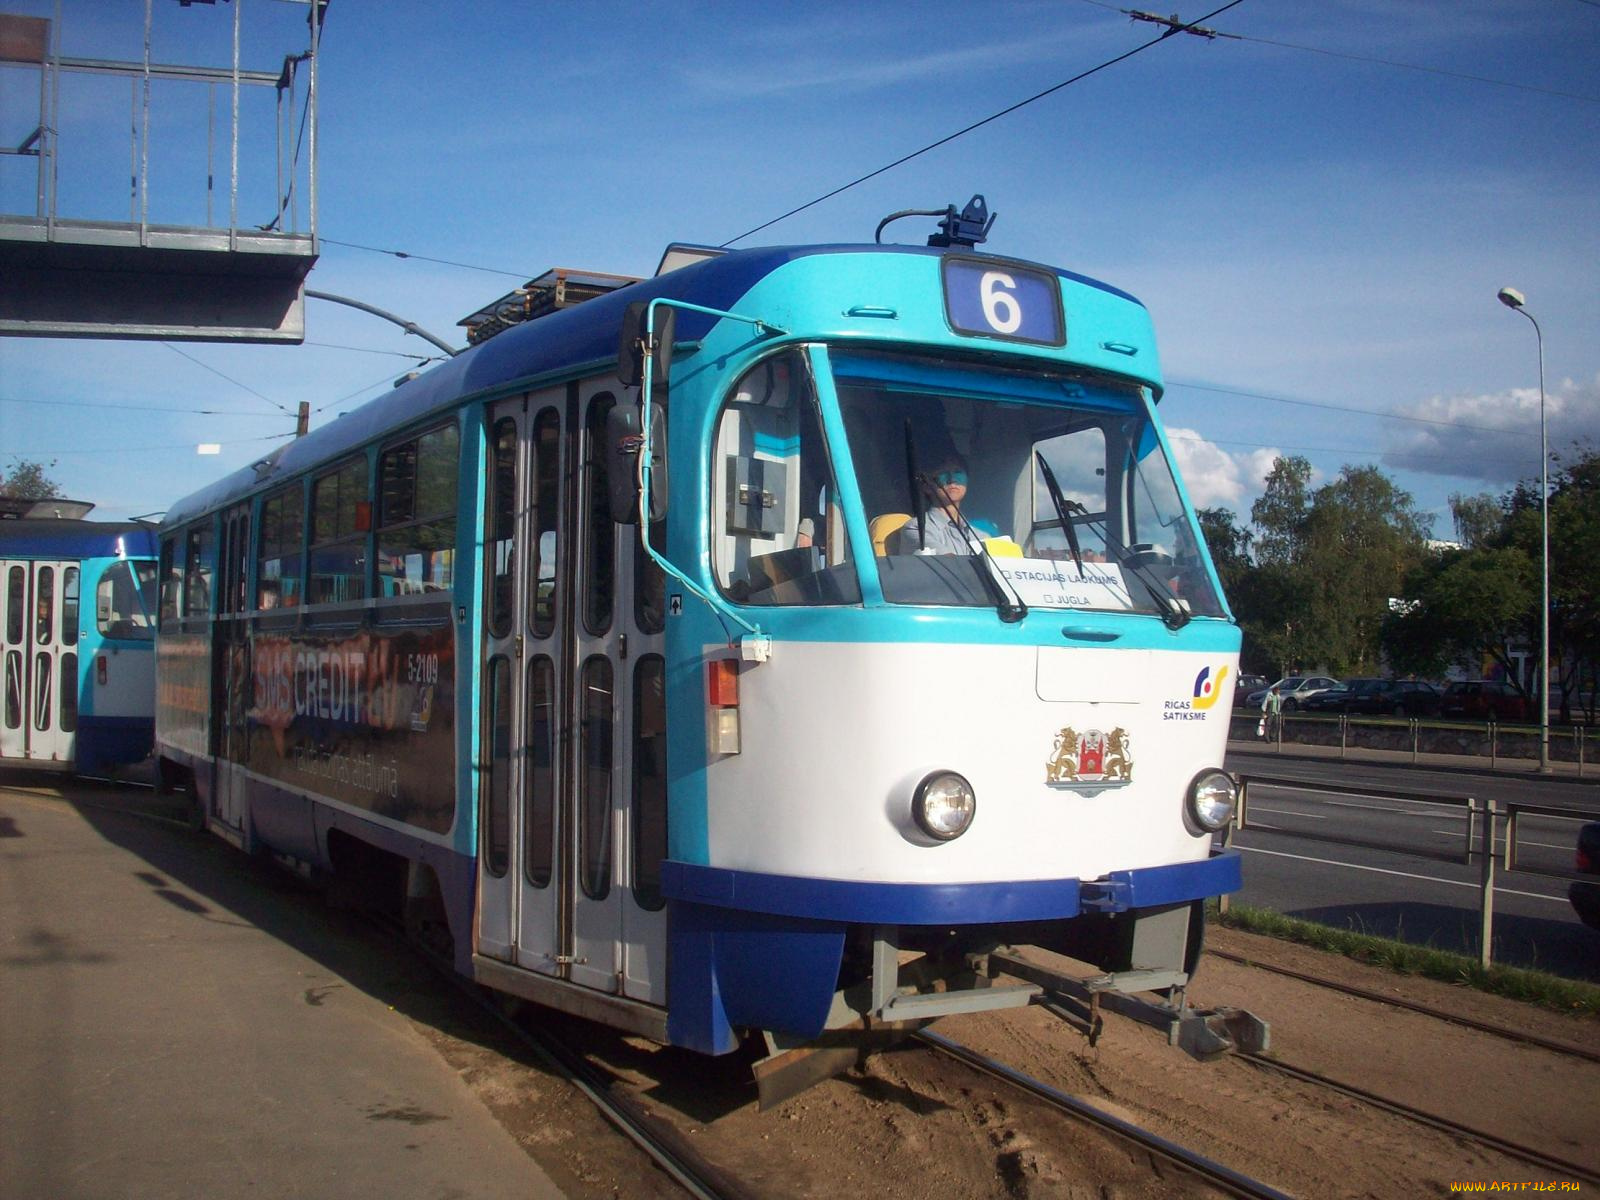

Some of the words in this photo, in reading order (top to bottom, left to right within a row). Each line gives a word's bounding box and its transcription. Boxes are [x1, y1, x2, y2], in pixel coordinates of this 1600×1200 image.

[980, 270, 1022, 334] 6
[1014, 571, 1066, 583] STACIJAS
[1057, 595, 1092, 606] JUGLA
[408, 653, 439, 684] 5-2109
[256, 652, 291, 710] SMS
[294, 652, 365, 724] CREDIT
[1163, 712, 1206, 721] SATIKSME
